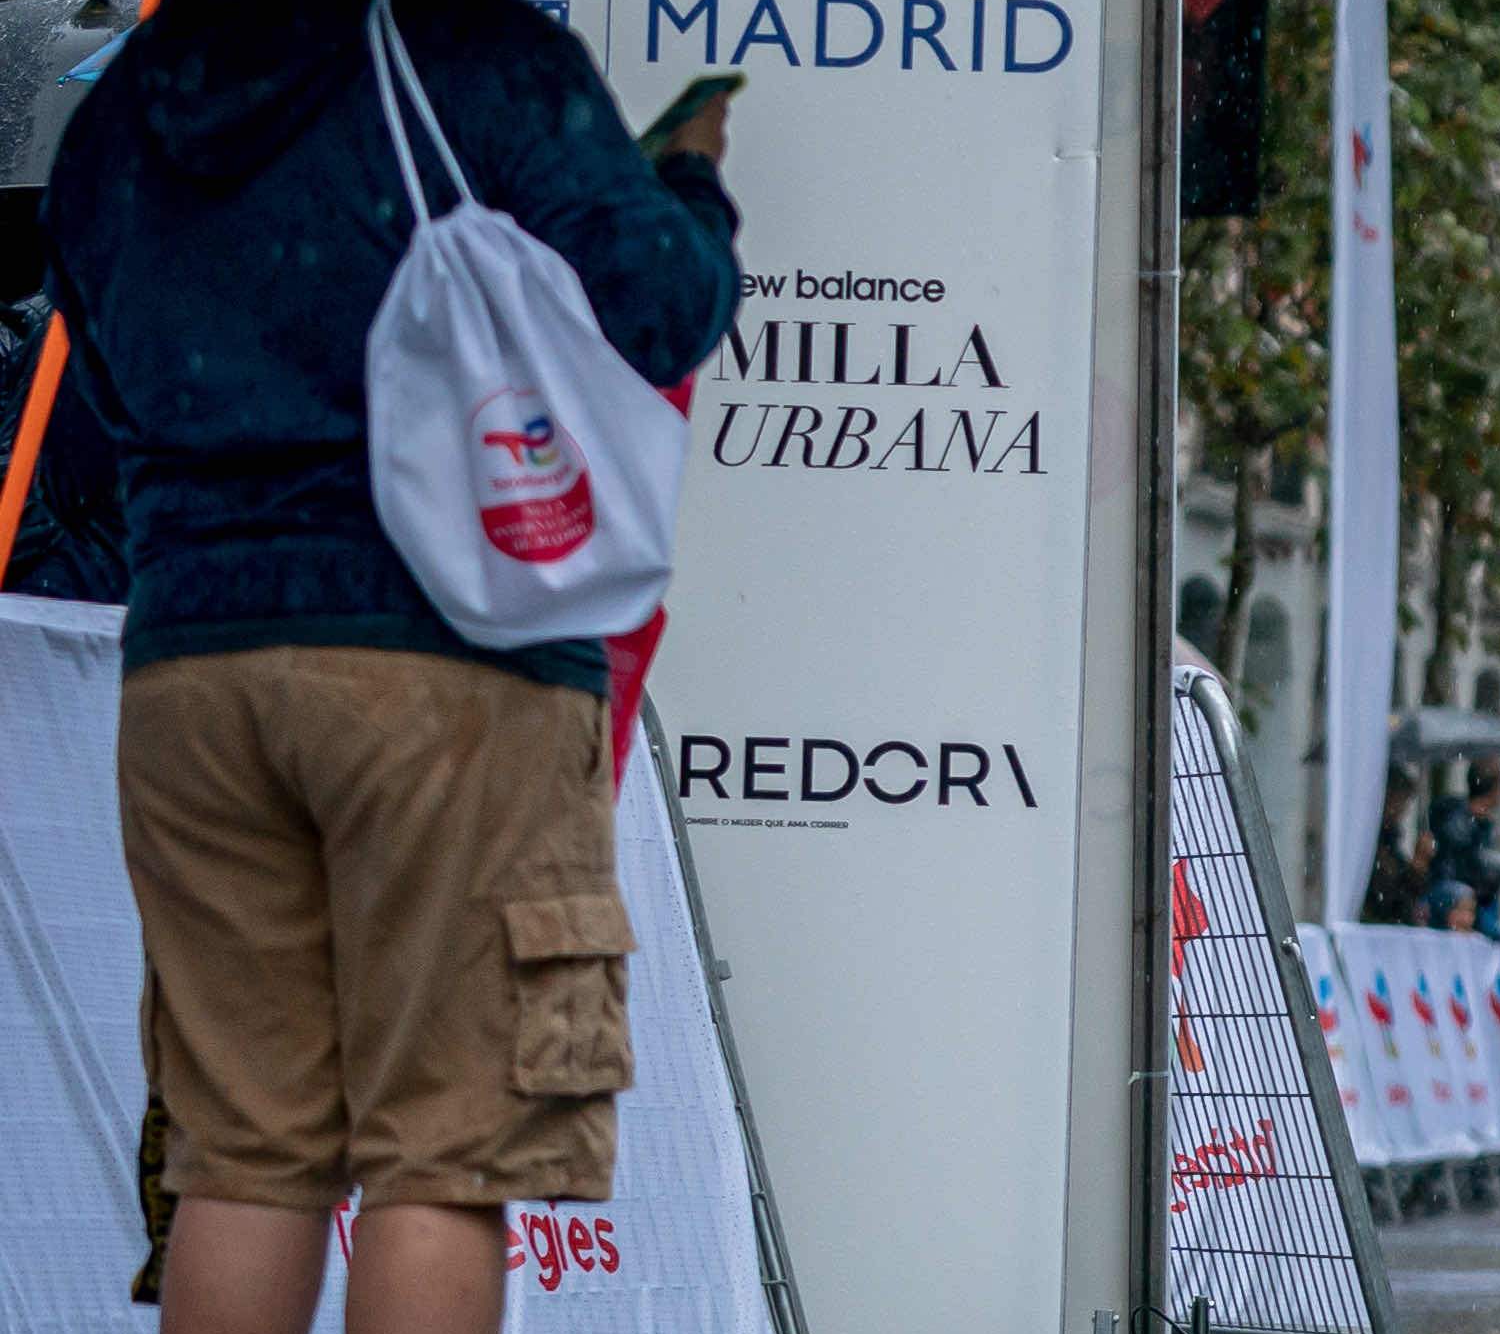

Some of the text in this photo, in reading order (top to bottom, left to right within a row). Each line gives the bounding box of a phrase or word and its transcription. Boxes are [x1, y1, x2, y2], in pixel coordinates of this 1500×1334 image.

[795, 269, 946, 303] balance
[711, 319, 1010, 389] MILLA
[713, 402, 1049, 475] URBANA
